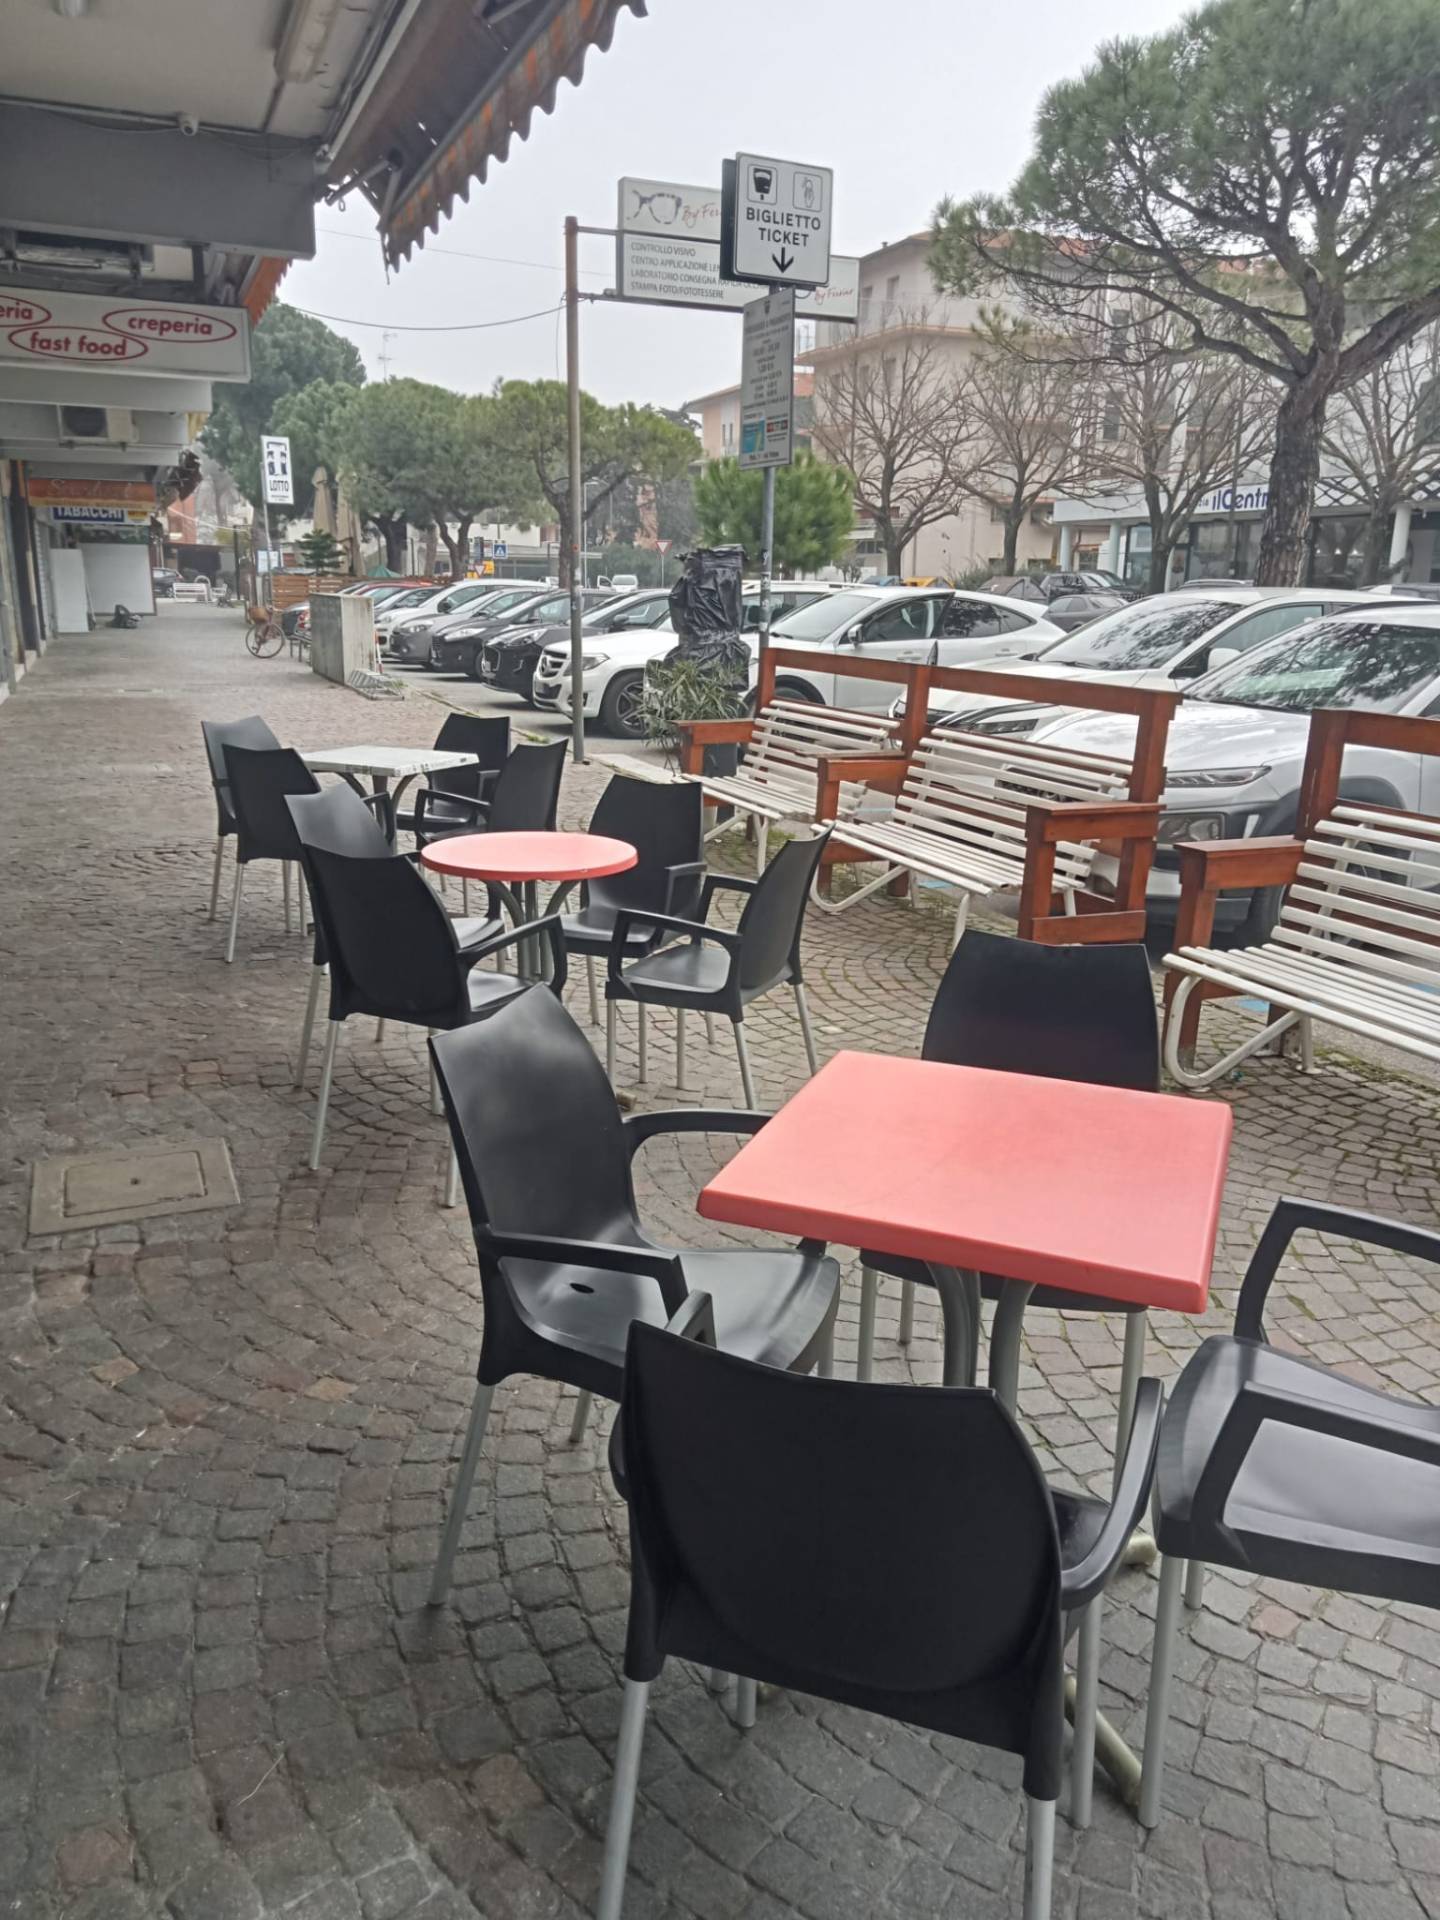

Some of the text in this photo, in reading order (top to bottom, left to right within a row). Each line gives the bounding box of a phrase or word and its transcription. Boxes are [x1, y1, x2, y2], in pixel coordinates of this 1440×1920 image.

[746, 206, 821, 231] BIGLIETTO
[758, 227, 809, 247] TICKET
[631, 242, 673, 254] CONTROLLO
[631, 255, 659, 266] CENTRO
[660, 258, 708, 272] APPLICAZIONE
[631, 281, 658, 292] STAMPA
[127, 316, 213, 336] creperia
[29, 331, 127, 356] fast food
[269, 479, 289, 492] LOTTO
[57, 506, 123, 519] TABACCHI
